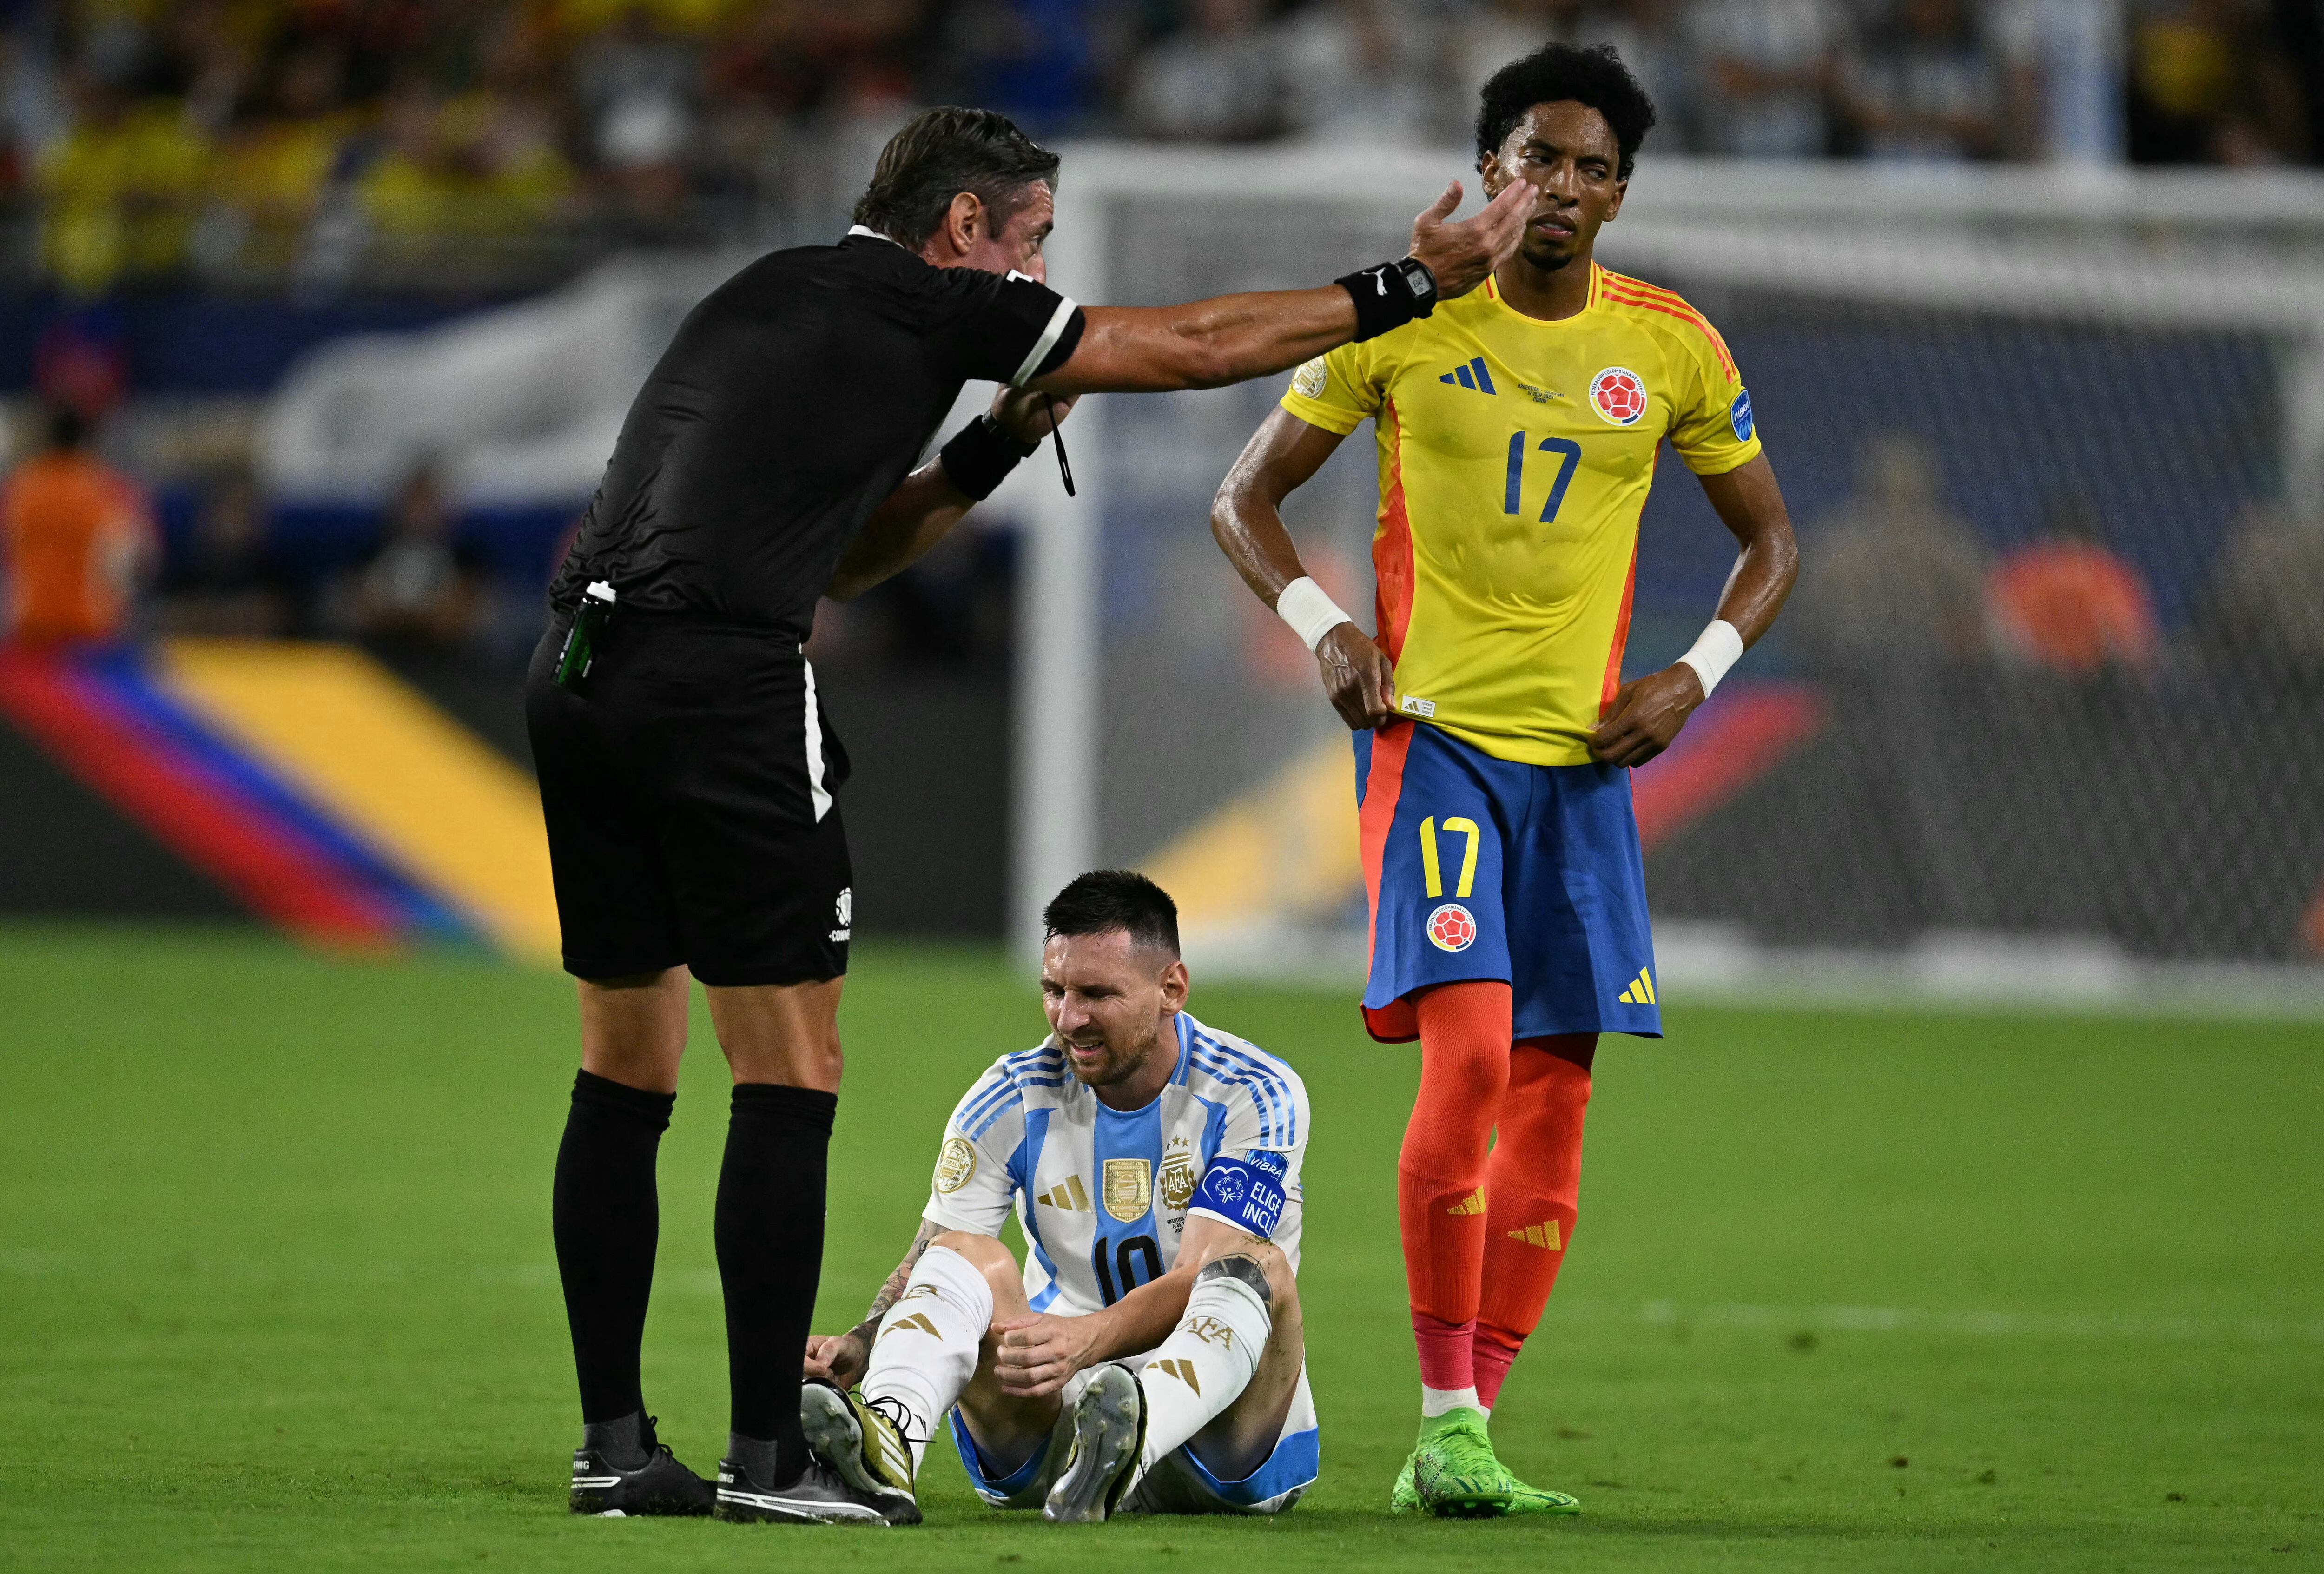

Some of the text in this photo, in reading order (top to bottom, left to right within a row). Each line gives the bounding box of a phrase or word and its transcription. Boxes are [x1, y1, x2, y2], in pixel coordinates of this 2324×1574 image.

[1604, 369, 1631, 377] COLOMBIANA
[1517, 384, 1539, 392] ARGENTINA
[1734, 400, 1750, 422] VIBRA
[1505, 430, 1582, 523] 17
[1420, 816, 1480, 898] 17
[1250, 1157, 1282, 1178] VIBRA
[1168, 1167, 1188, 1194] AFA
[1250, 1181, 1281, 1217] ELIGE
[1167, 1216, 1184, 1224] ARGENTINA
[1094, 1235, 1162, 1308] 10
